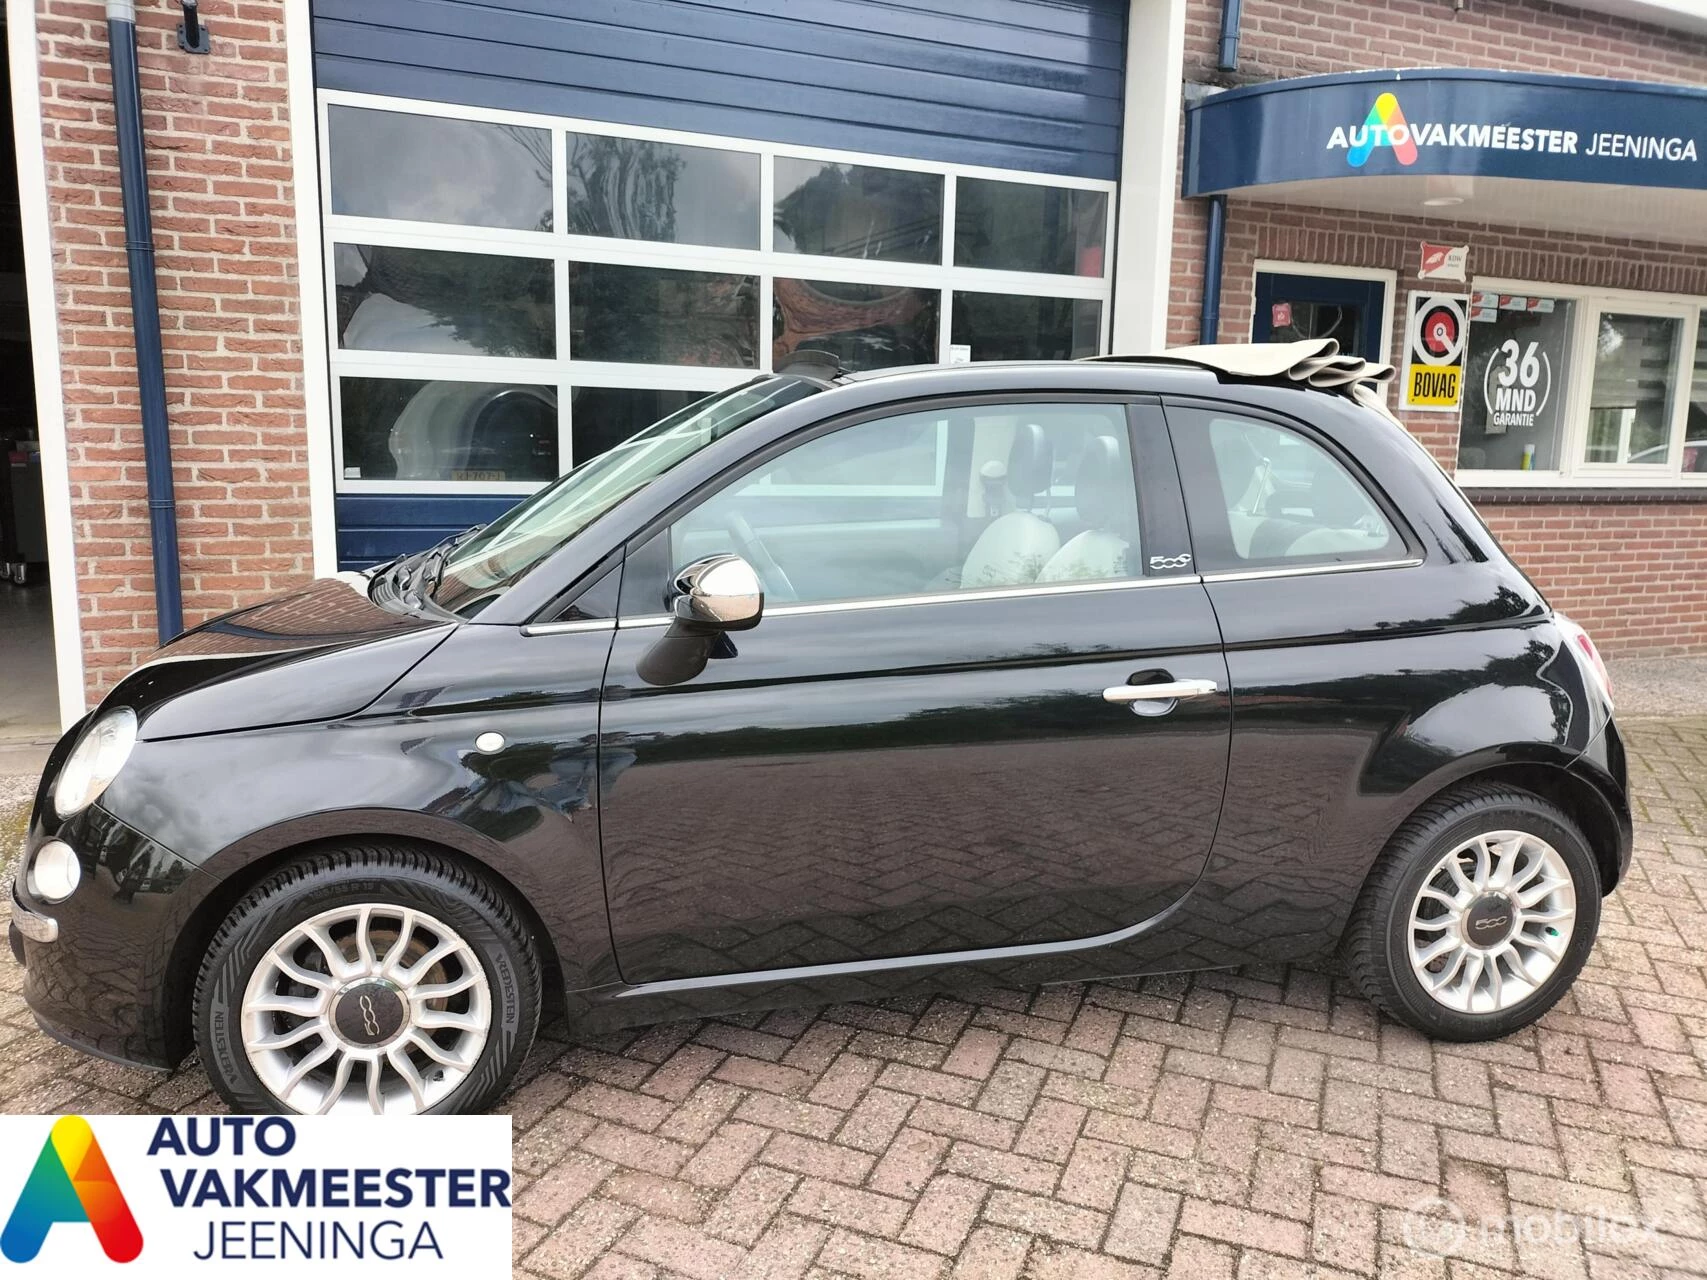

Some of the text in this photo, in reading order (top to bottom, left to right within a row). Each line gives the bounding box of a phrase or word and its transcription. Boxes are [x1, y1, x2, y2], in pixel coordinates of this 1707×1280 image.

[1326, 122, 1698, 162] AUTOVAKMEESTER JEENINGA
[1497, 339, 1541, 388] 36
[1413, 372, 1457, 399] BOVAG
[1494, 388, 1537, 412] MND
[1493, 413, 1536, 427] GARANTIE
[1475, 915, 1508, 930] 500
[359, 995, 380, 1036] 500
